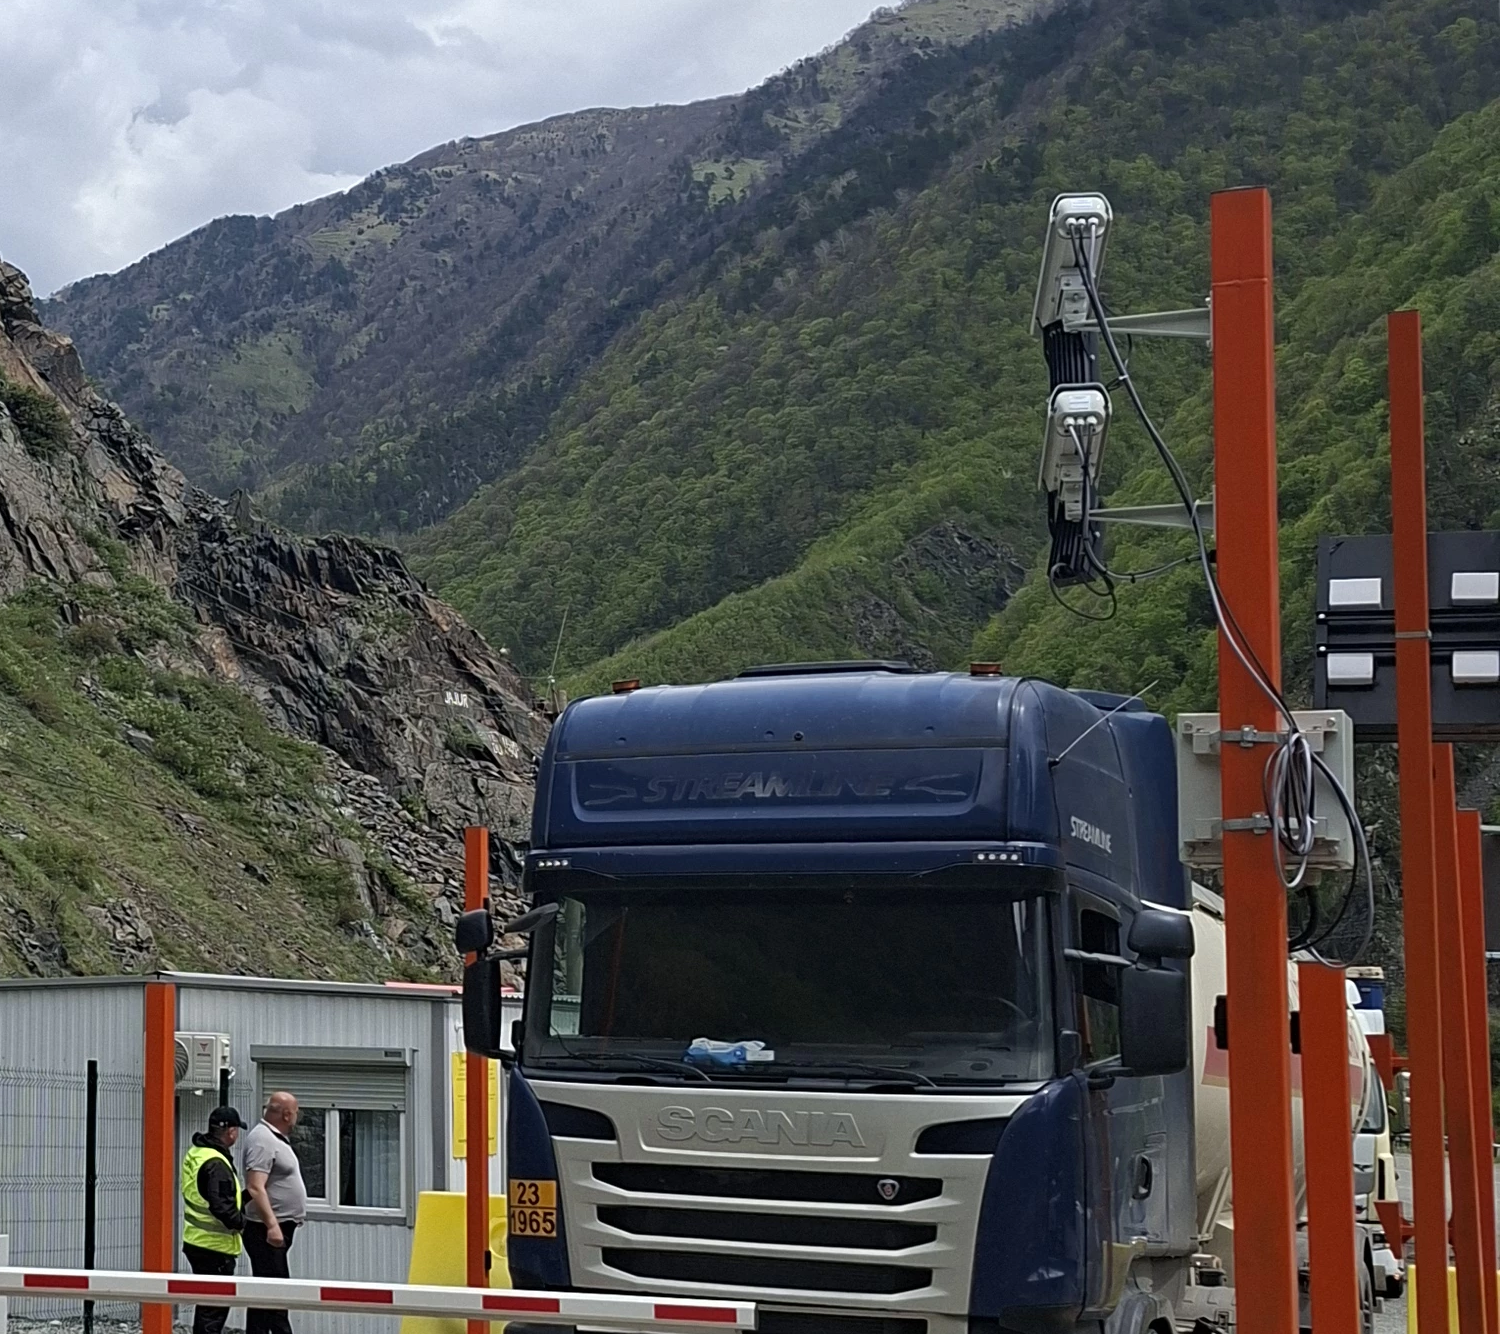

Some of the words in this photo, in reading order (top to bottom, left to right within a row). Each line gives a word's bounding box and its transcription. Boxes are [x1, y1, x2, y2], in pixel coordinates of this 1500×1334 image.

[642, 770, 895, 803] STREAMLINE
[656, 1105, 866, 1148] SCANIA
[517, 1181, 540, 1206] 23
[511, 1209, 555, 1235] 1965
